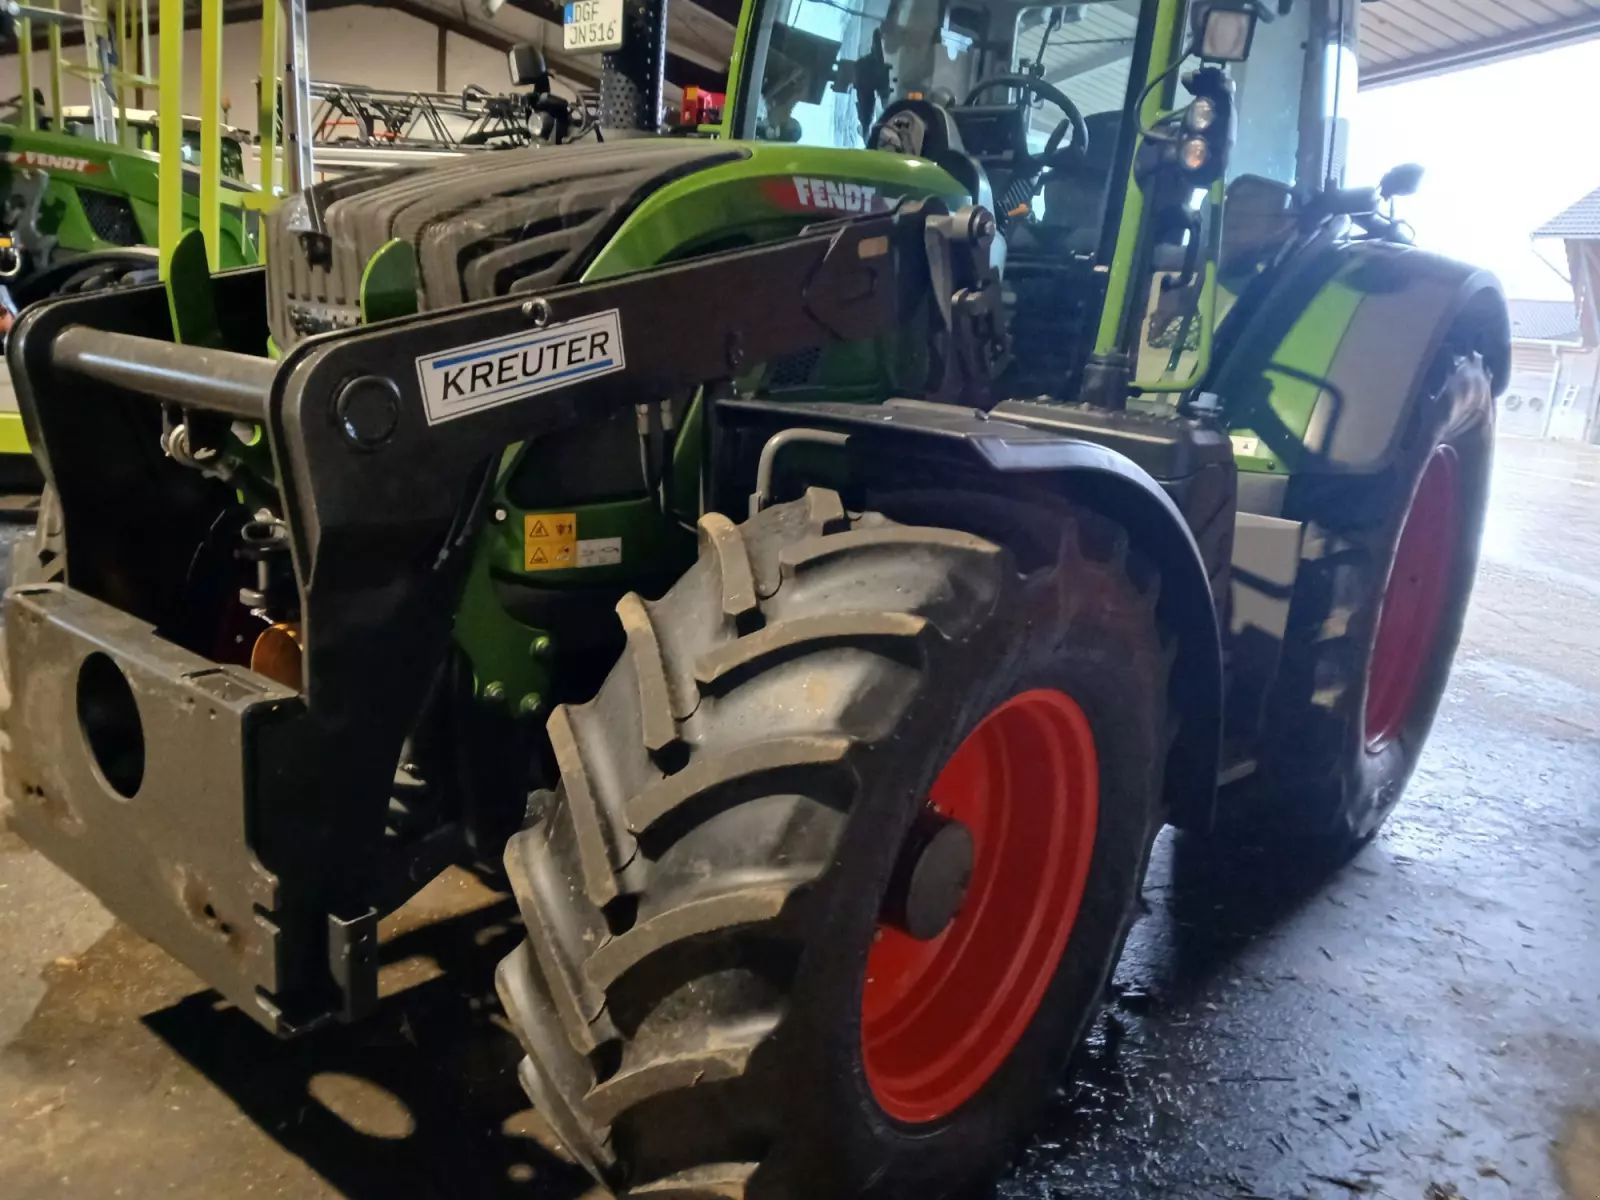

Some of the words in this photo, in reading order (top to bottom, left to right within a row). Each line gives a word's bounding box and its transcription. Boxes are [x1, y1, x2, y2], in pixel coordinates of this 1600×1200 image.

[575, 1, 600, 22] DGF
[792, 176, 876, 213] FENDT
[442, 330, 610, 401] KREUTER
